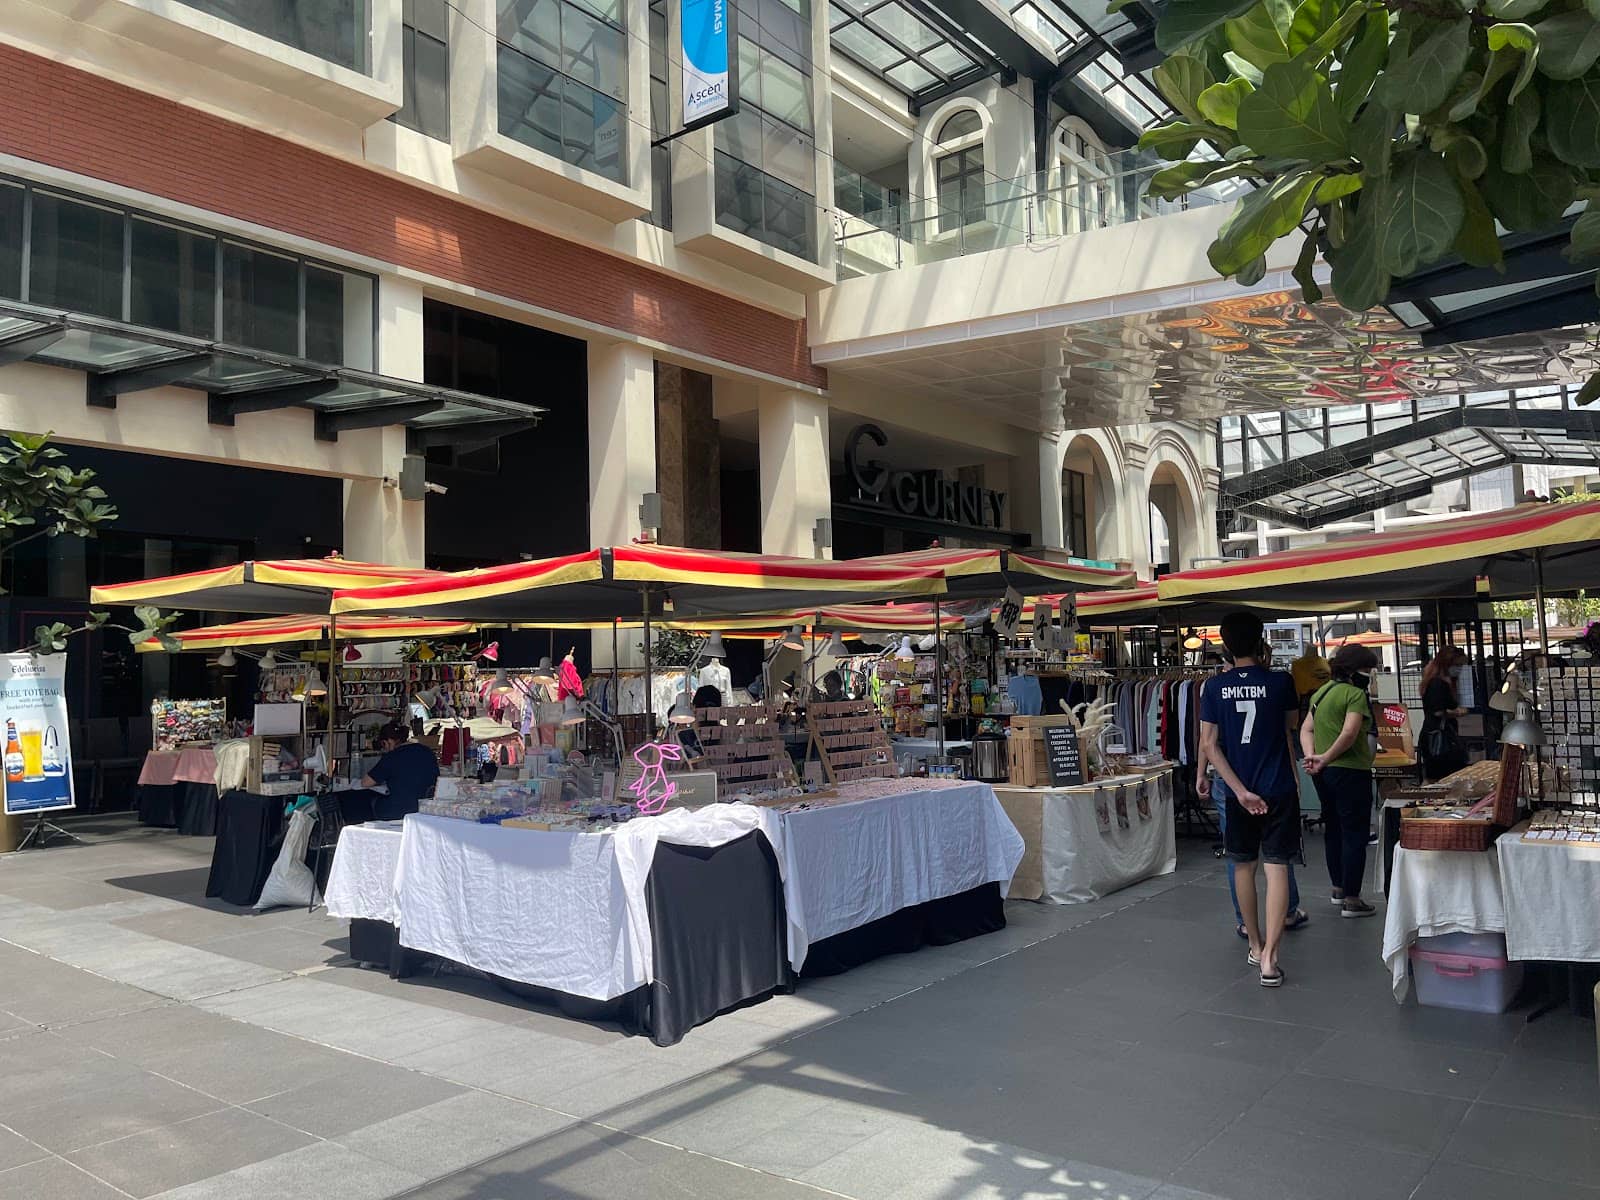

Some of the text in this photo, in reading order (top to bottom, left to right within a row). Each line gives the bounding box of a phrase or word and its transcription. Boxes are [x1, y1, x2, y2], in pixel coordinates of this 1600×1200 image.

[844, 423, 1008, 530] G GURNEY
[0, 689, 21, 699] FREE
[1221, 685, 1267, 700] SMKTBM
[1383, 707, 1407, 718] MUST
[1235, 700, 1257, 745] 7
